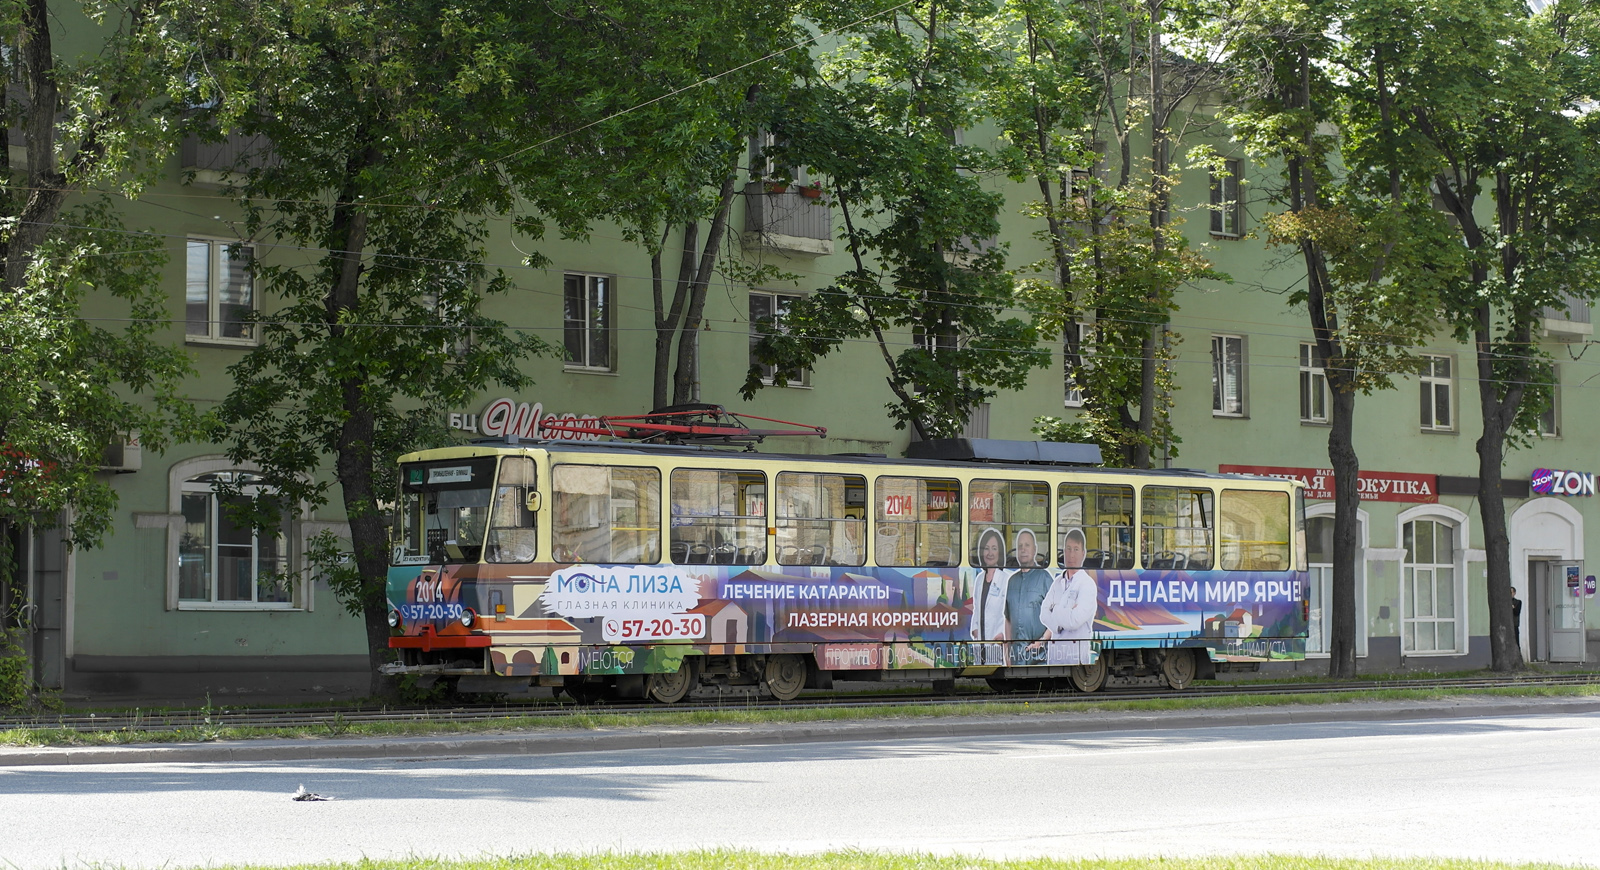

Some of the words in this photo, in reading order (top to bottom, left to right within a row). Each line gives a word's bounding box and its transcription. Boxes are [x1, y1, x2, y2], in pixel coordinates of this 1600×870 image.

[450, 413, 477, 433] БЦ
[1357, 477, 1431, 495] ОКУПКА
[886, 495, 912, 515] 2014
[395, 547, 402, 564] 2
[416, 581, 443, 603] 2014
[557, 573, 620, 593] МОНА
[626, 575, 683, 593] ЛИЗА
[722, 584, 795, 600] ЛЕЧЕНИЕ
[799, 585, 890, 600] КАТАРАКТЫ
[1586, 581, 1596, 589] WB
[1107, 580, 1198, 606] ДЕЛАЕМ
[1205, 581, 1249, 602] МИР
[1254, 580, 1301, 602] ЯРЧЕ!
[410, 603, 463, 620] 57-20-30
[557, 601, 618, 610] ГЛАЗНАЯ
[623, 601, 683, 610] КЛИНИКА
[621, 618, 702, 637] 57-20-30
[787, 612, 868, 627] ЛАЗЕРНАЯ
[872, 611, 959, 628] КОРРЕКЦИЯ
[571, 651, 634, 669] ИМЕЮТСЯ
